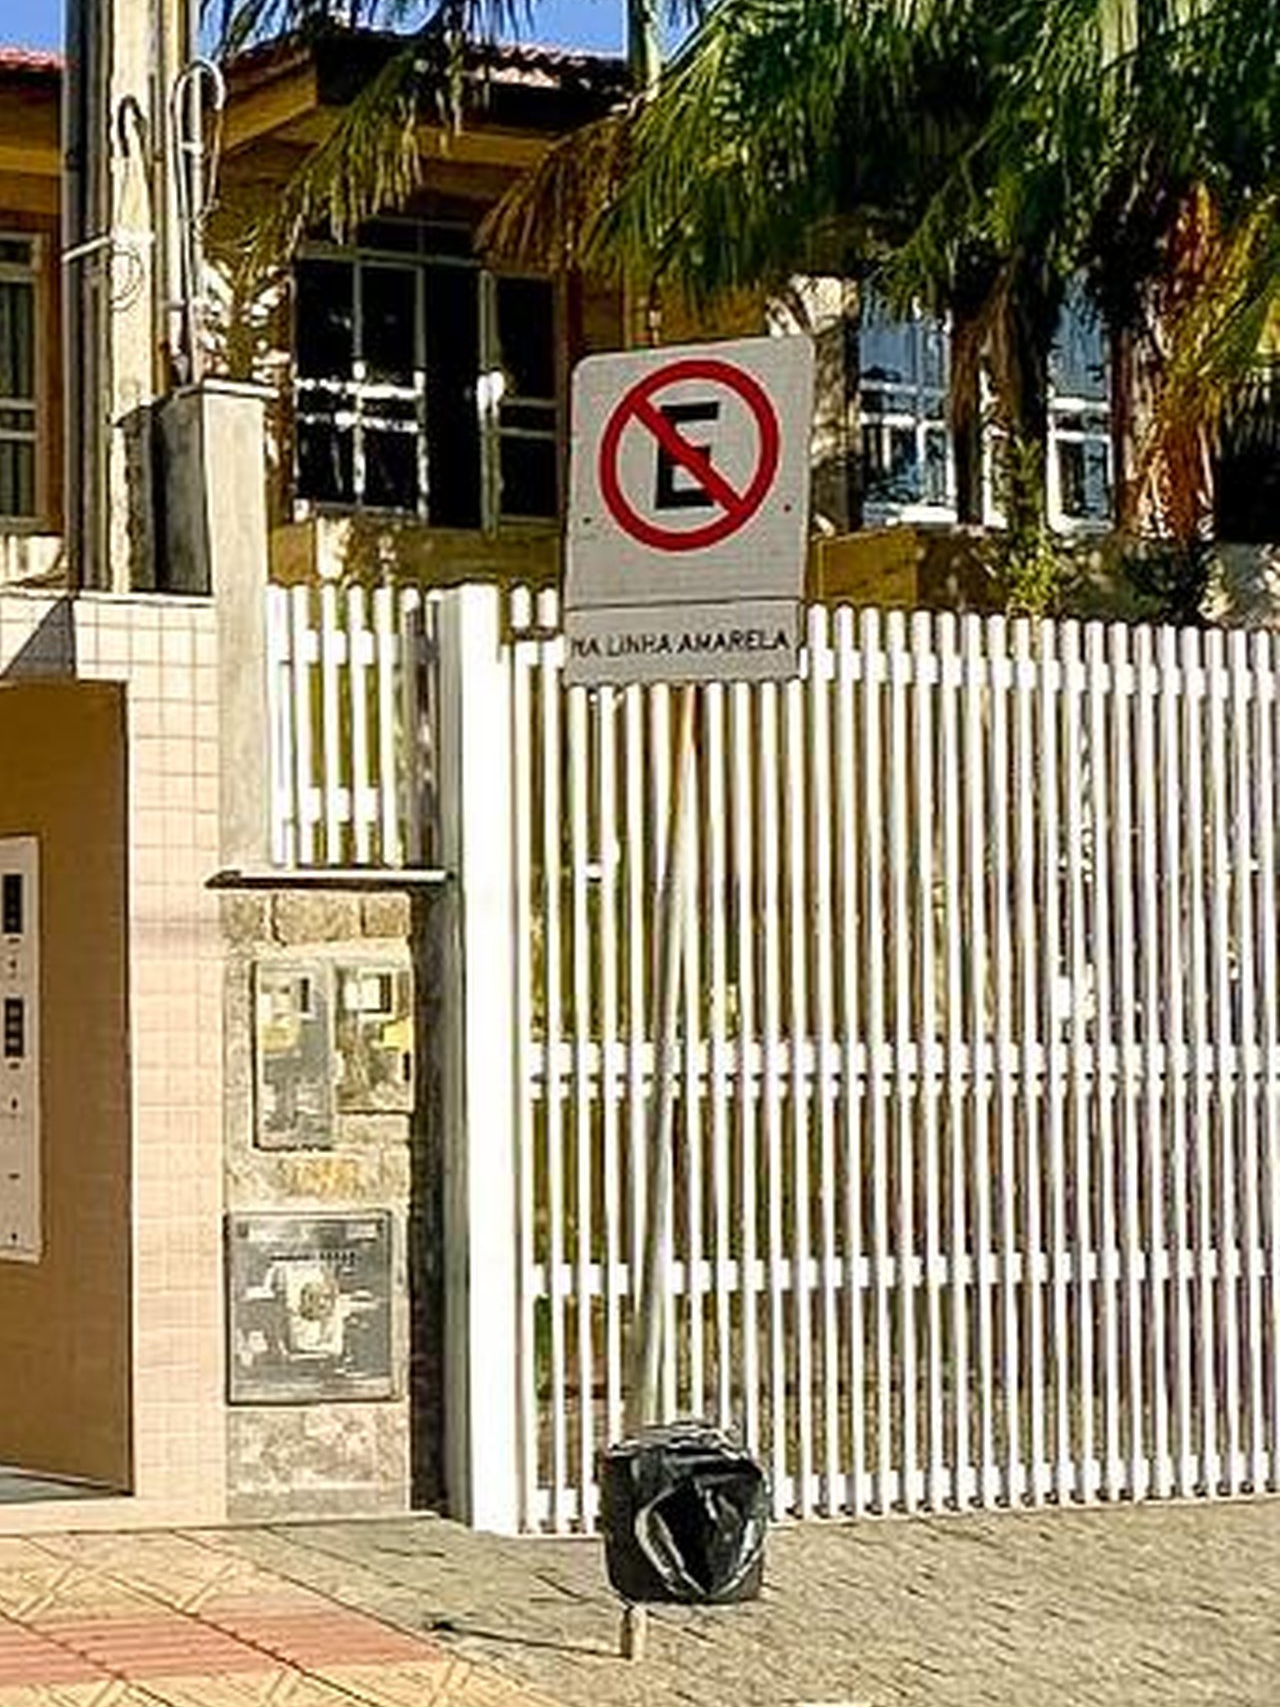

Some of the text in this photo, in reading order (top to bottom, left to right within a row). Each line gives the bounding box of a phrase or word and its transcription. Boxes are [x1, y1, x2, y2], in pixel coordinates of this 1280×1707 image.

[655, 400, 721, 510] E
[571, 629, 789, 658] NA LINHA AMARELA
